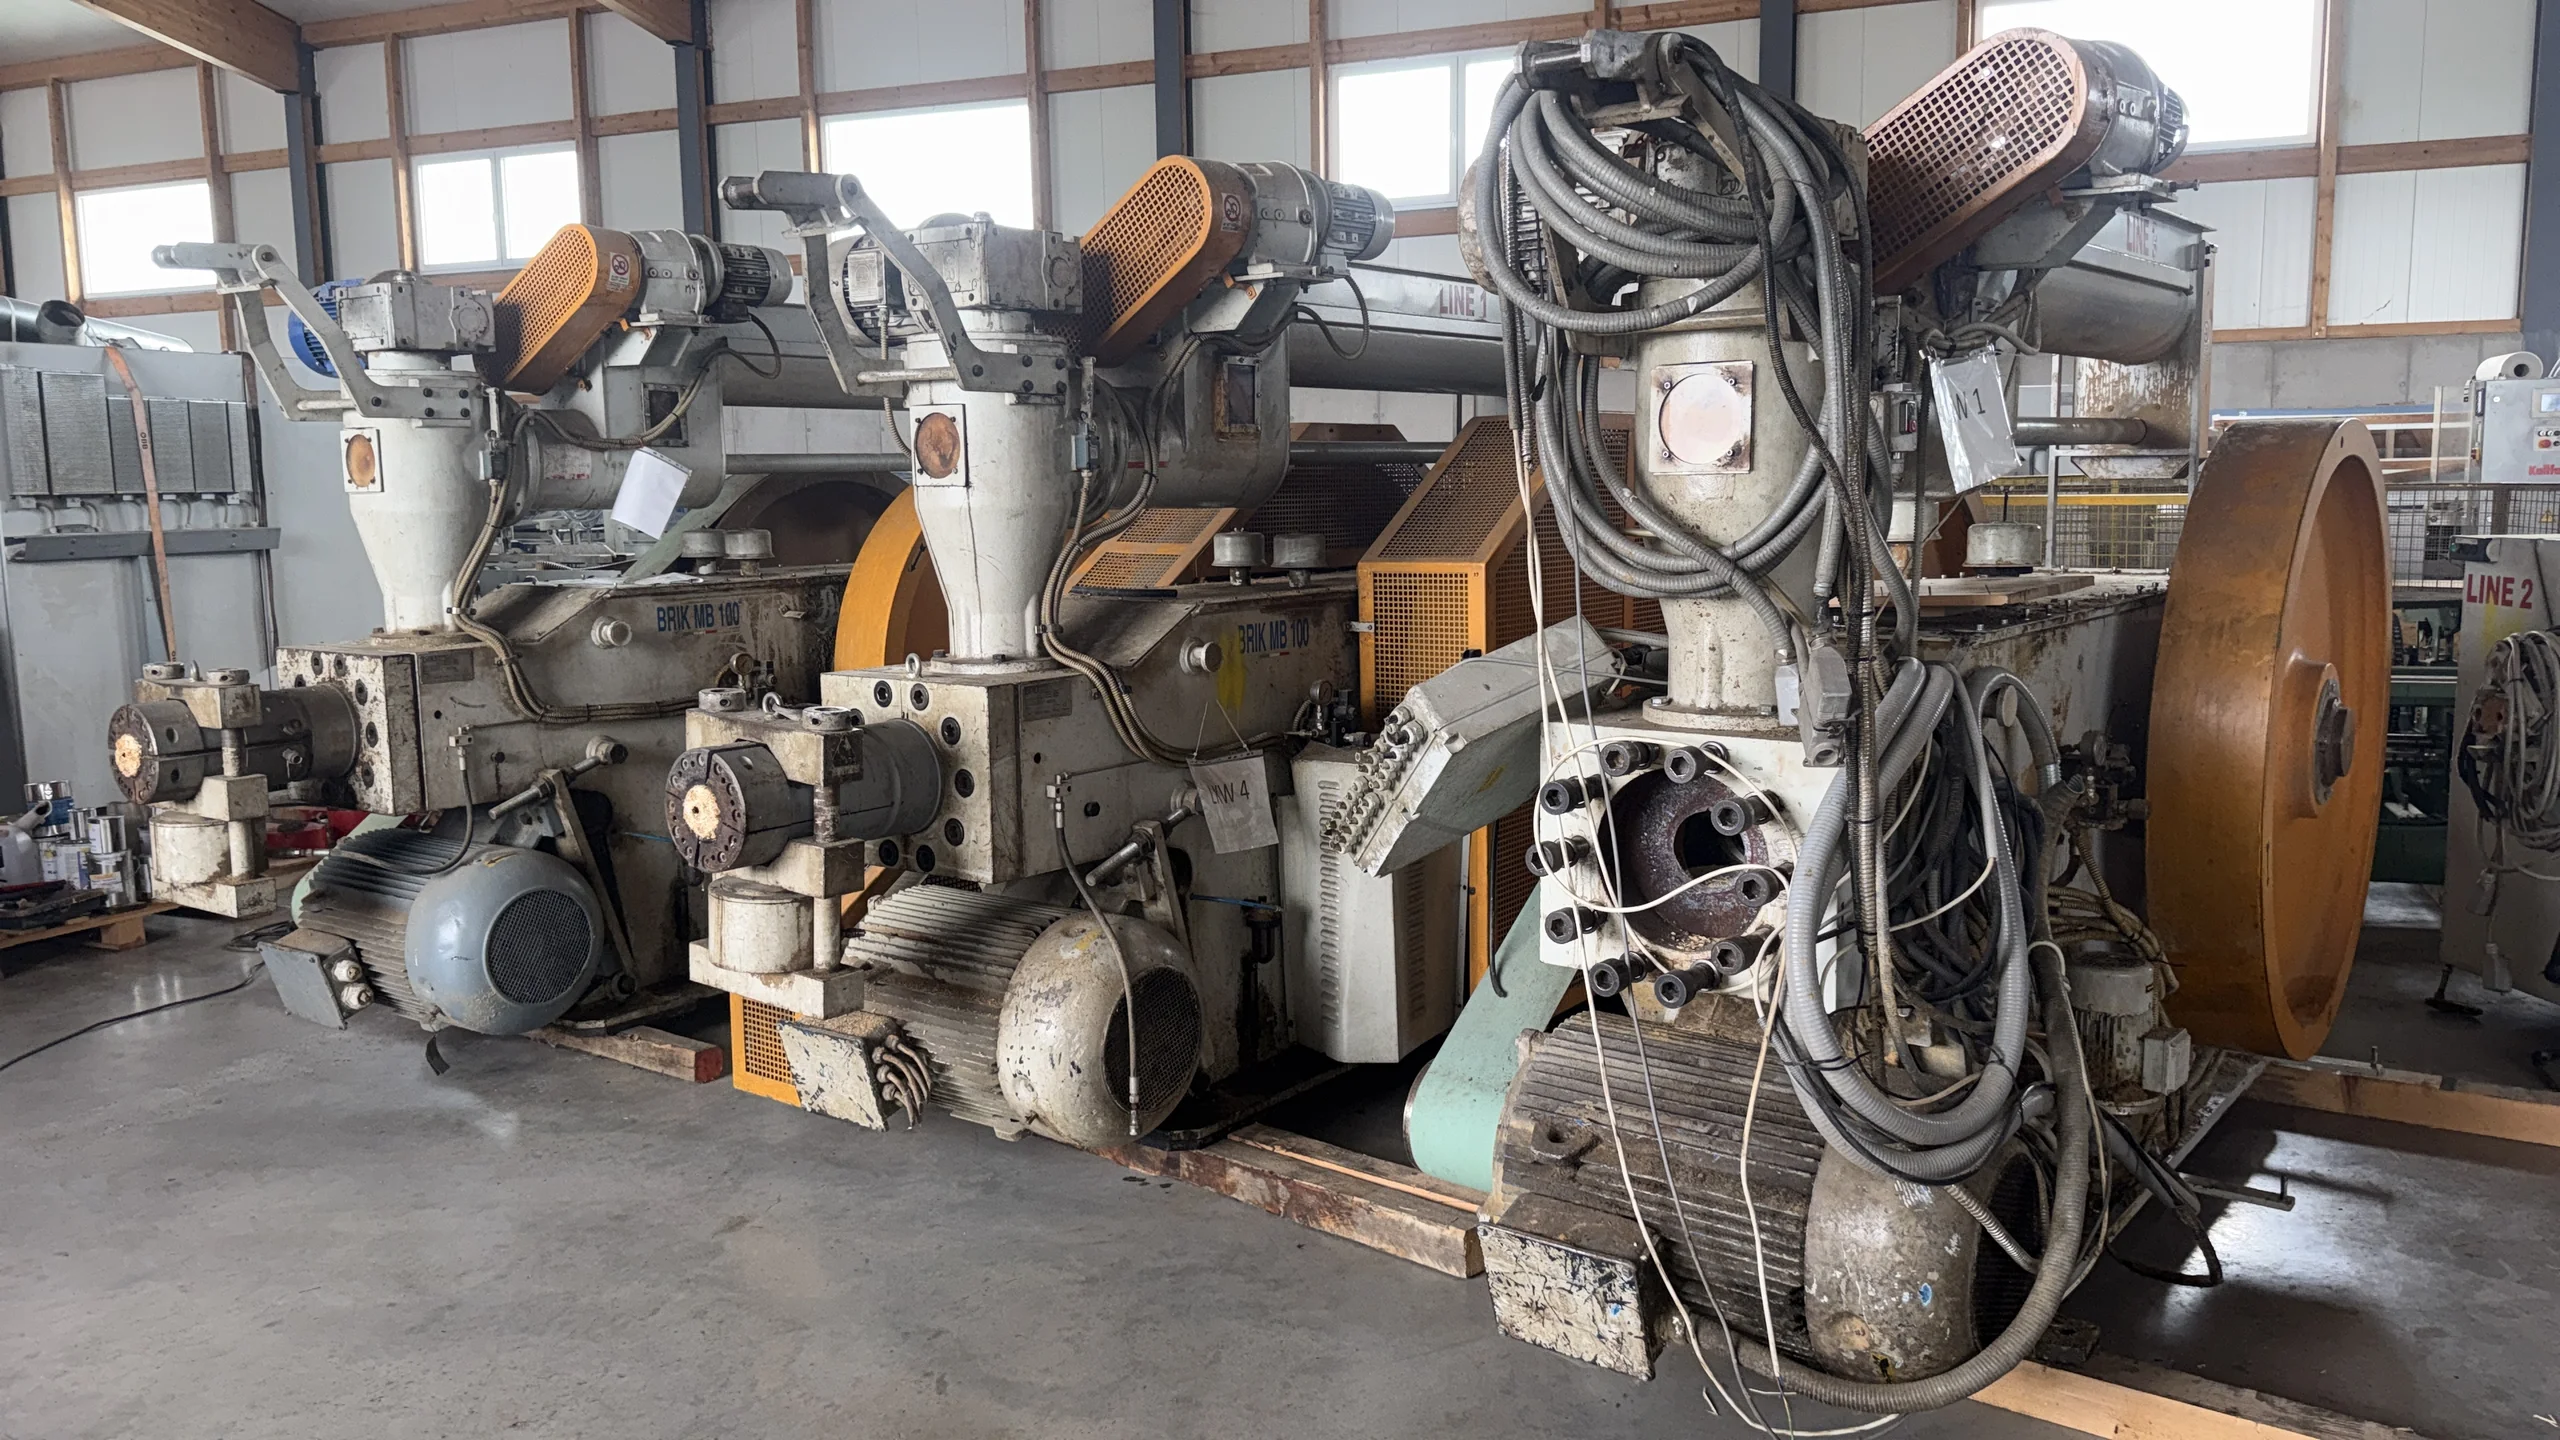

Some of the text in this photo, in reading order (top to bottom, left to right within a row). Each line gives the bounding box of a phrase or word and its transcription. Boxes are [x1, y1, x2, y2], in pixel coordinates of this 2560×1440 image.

[2126, 213, 2149, 256] LINE
[1439, 284, 1487, 318] LINE 1
[1973, 388, 1986, 415] 1
[2466, 573, 2533, 609] LINE 2
[656, 601, 740, 632] BRIK MB 100
[1238, 617, 1309, 654] BRIK MB 100
[1240, 779, 1250, 800] 4
